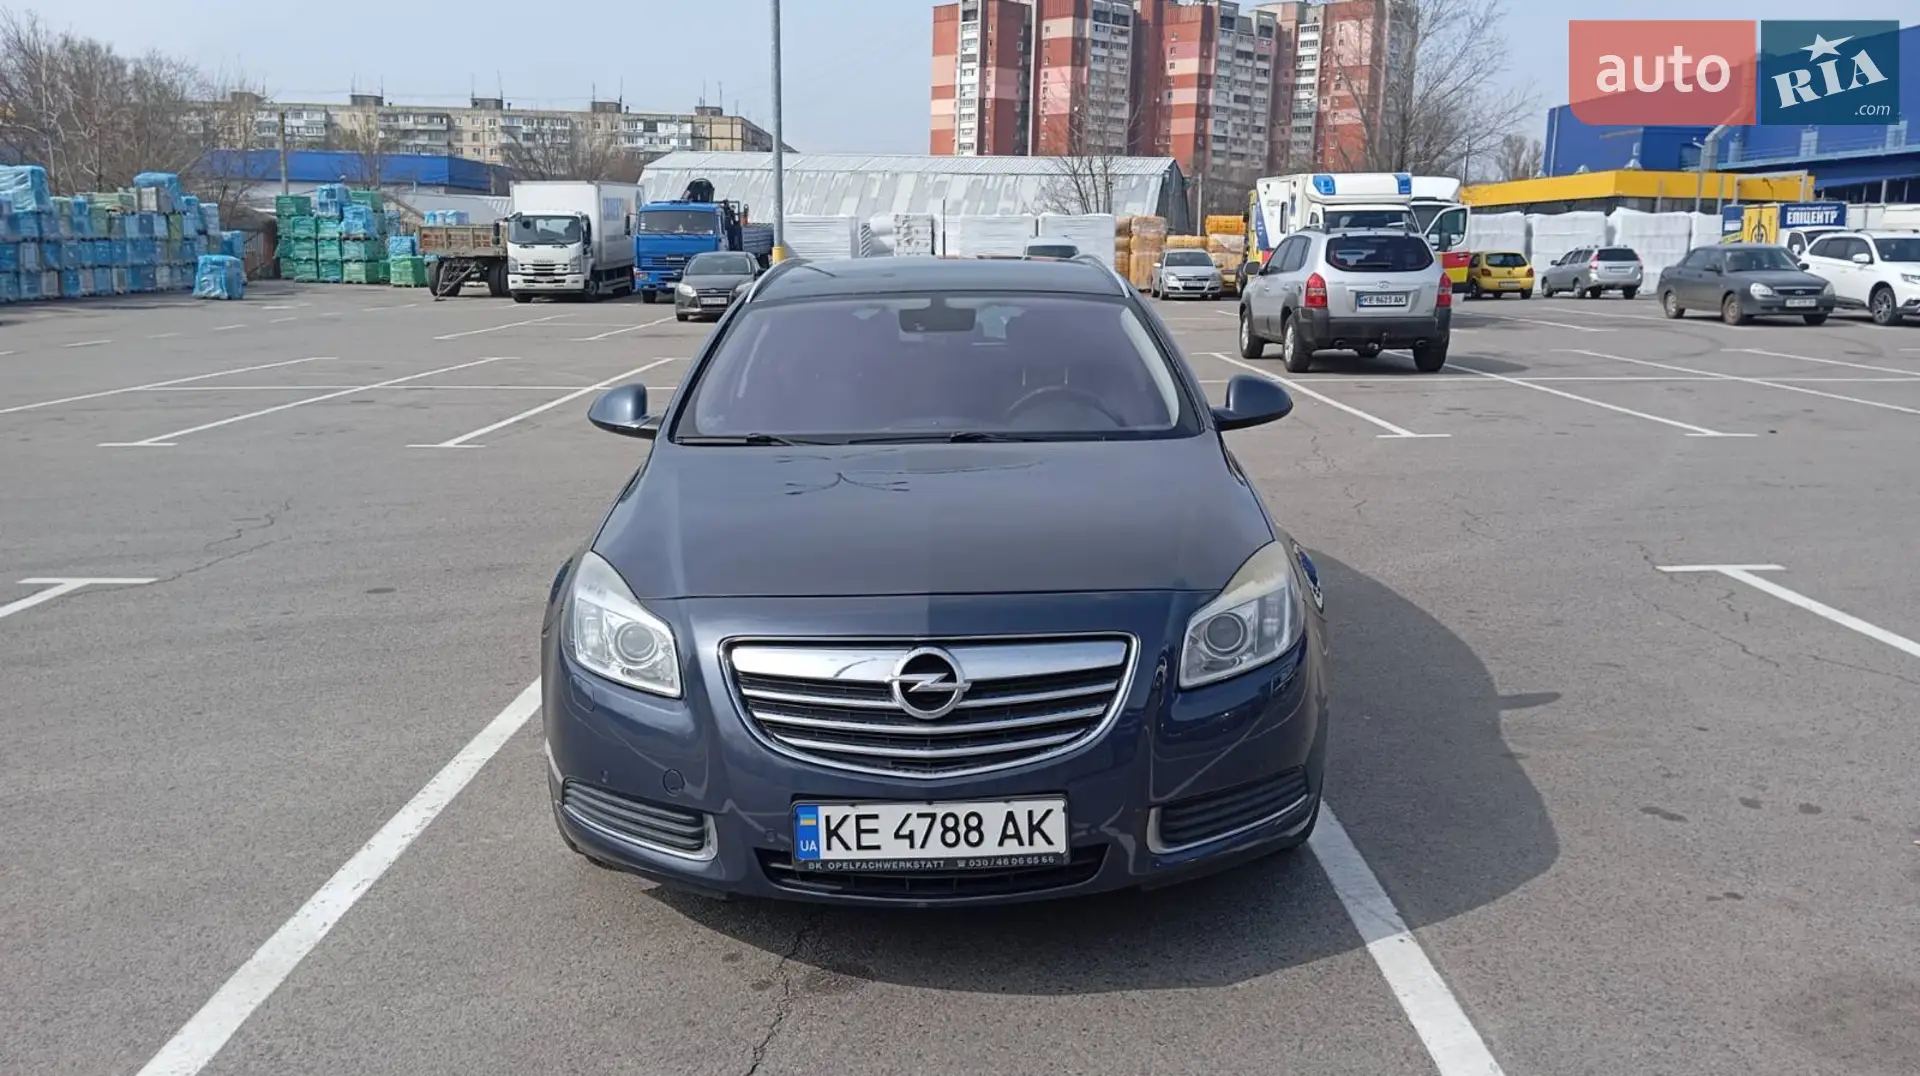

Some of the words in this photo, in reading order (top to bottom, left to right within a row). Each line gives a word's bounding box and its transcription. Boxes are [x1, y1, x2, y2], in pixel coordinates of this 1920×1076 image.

[1786, 210, 1838, 225] ЕПІЦЕНТР
[825, 813, 881, 851] KE
[893, 811, 984, 849] 4788
[997, 808, 1054, 847] AK
[800, 840, 818, 852] UA
[828, 860, 945, 870] OPELFACHWERKSTATT
